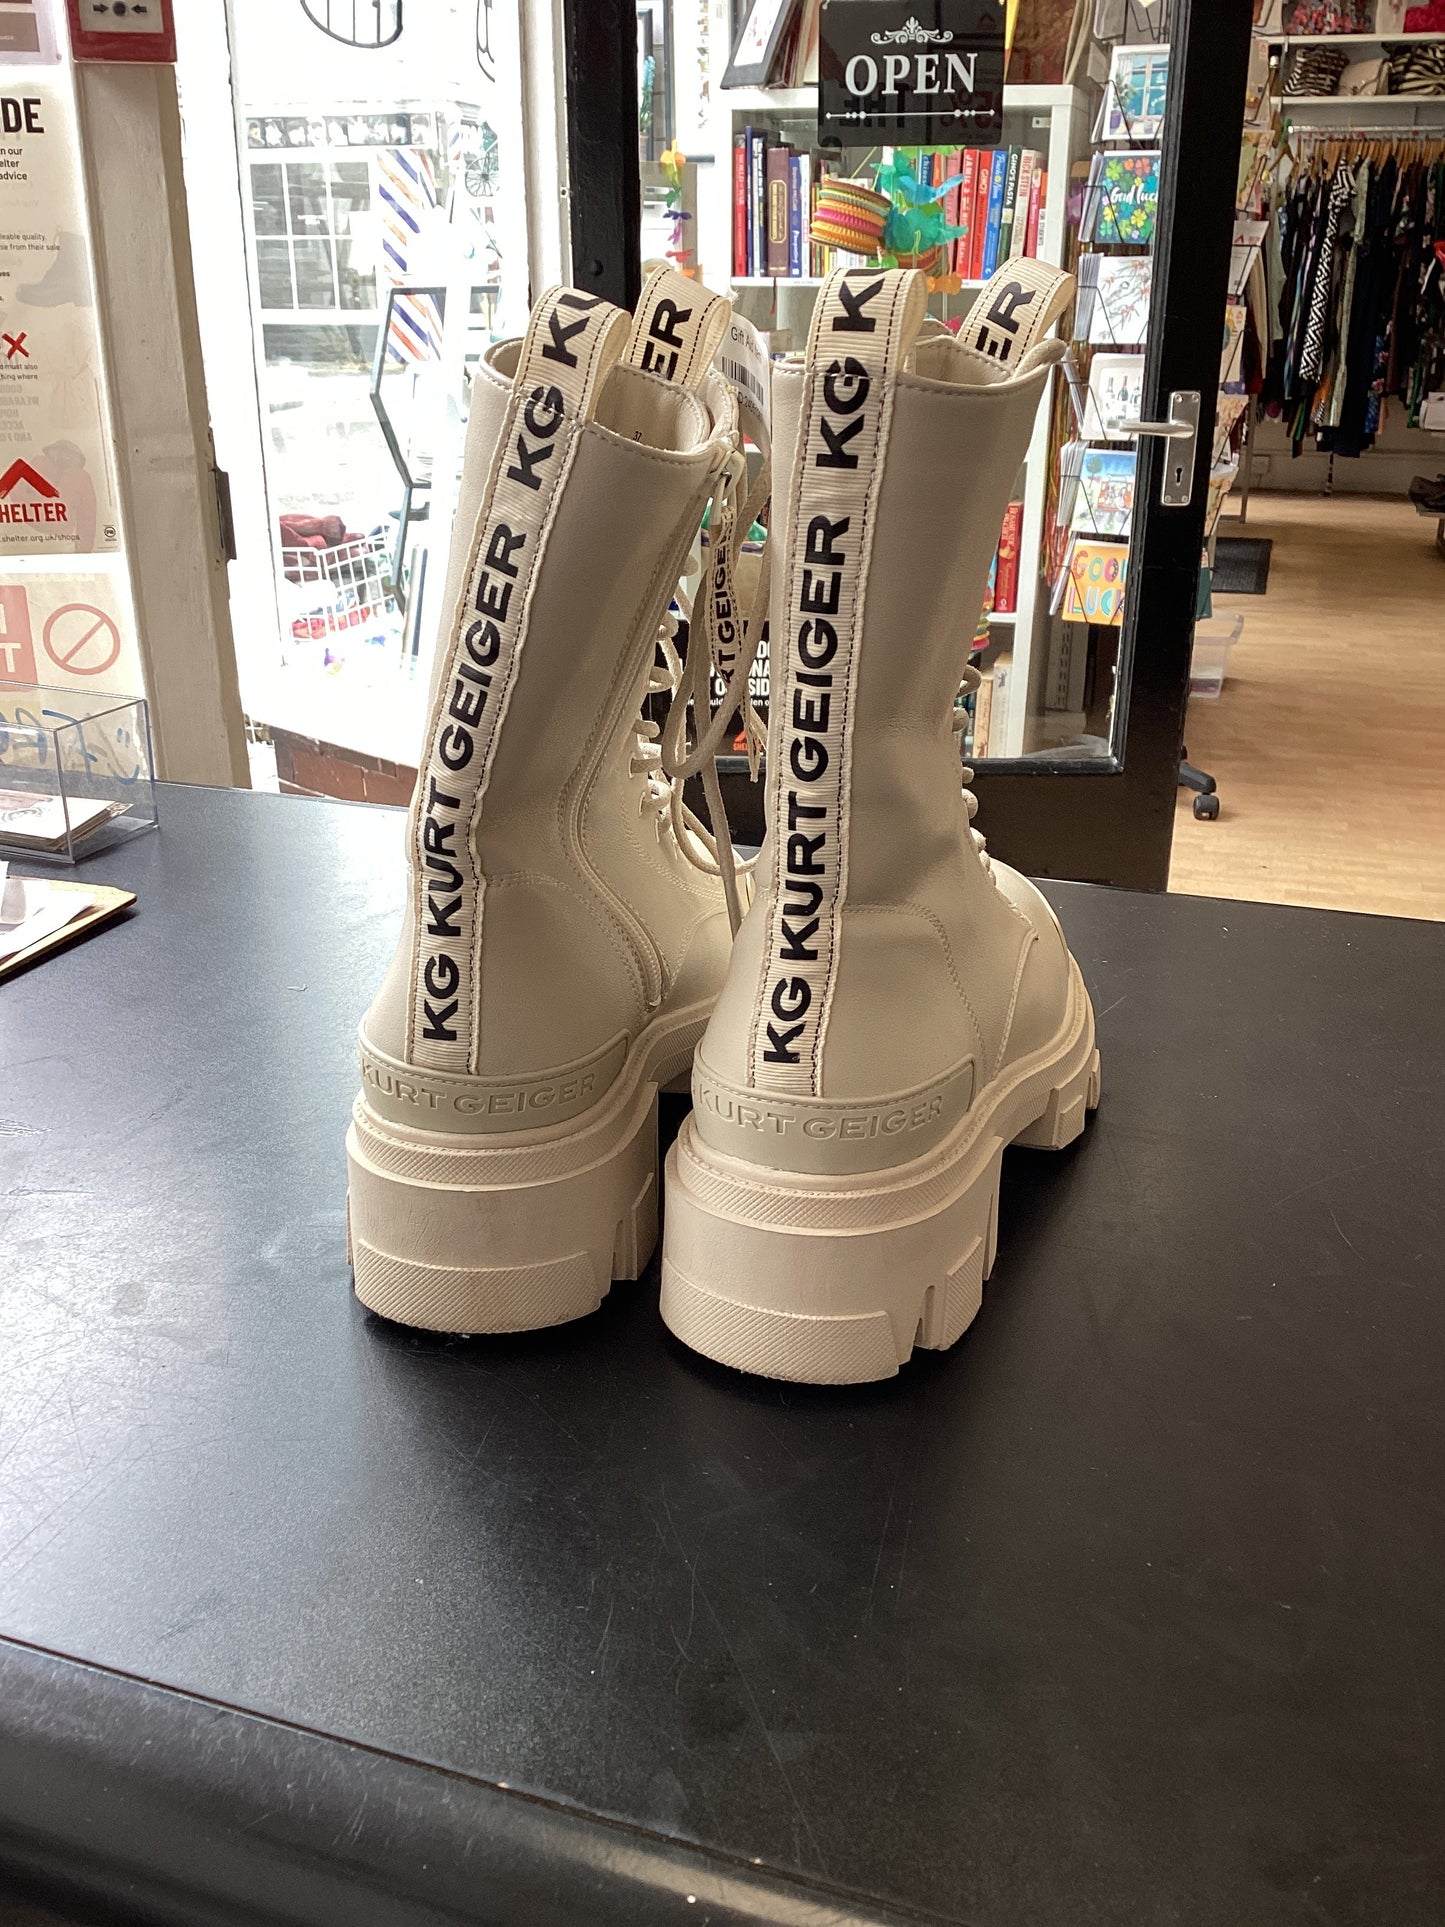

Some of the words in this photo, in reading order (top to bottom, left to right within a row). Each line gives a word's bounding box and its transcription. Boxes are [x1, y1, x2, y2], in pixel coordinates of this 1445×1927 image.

[845, 53, 978, 96] OPEN
[8, 148, 23, 156] our
[1009, 153, 1019, 179] GINO'S
[1005, 179, 1016, 206] PASTA
[9, 243, 27, 251] from
[28, 243, 45, 251] their
[22, 233, 45, 242] quality
[730, 326, 745, 346] Gift
[506, 385, 565, 491] KG
[632, 430, 644, 442] 37
[815, 357, 871, 469] KG
[0, 502, 68, 524] HELTER
[438, 523, 527, 771] GEIGER
[789, 514, 850, 783] GEIGER
[423, 775, 465, 937] KURT
[779, 790, 828, 961] KURT
[422, 953, 460, 1042] KG
[763, 976, 812, 1063] KG
[361, 1060, 448, 1110] KURT
[453, 1071, 597, 1116] GEIGER
[700, 1087, 797, 1136] KURT
[802, 1094, 943, 1141] GEIGER
